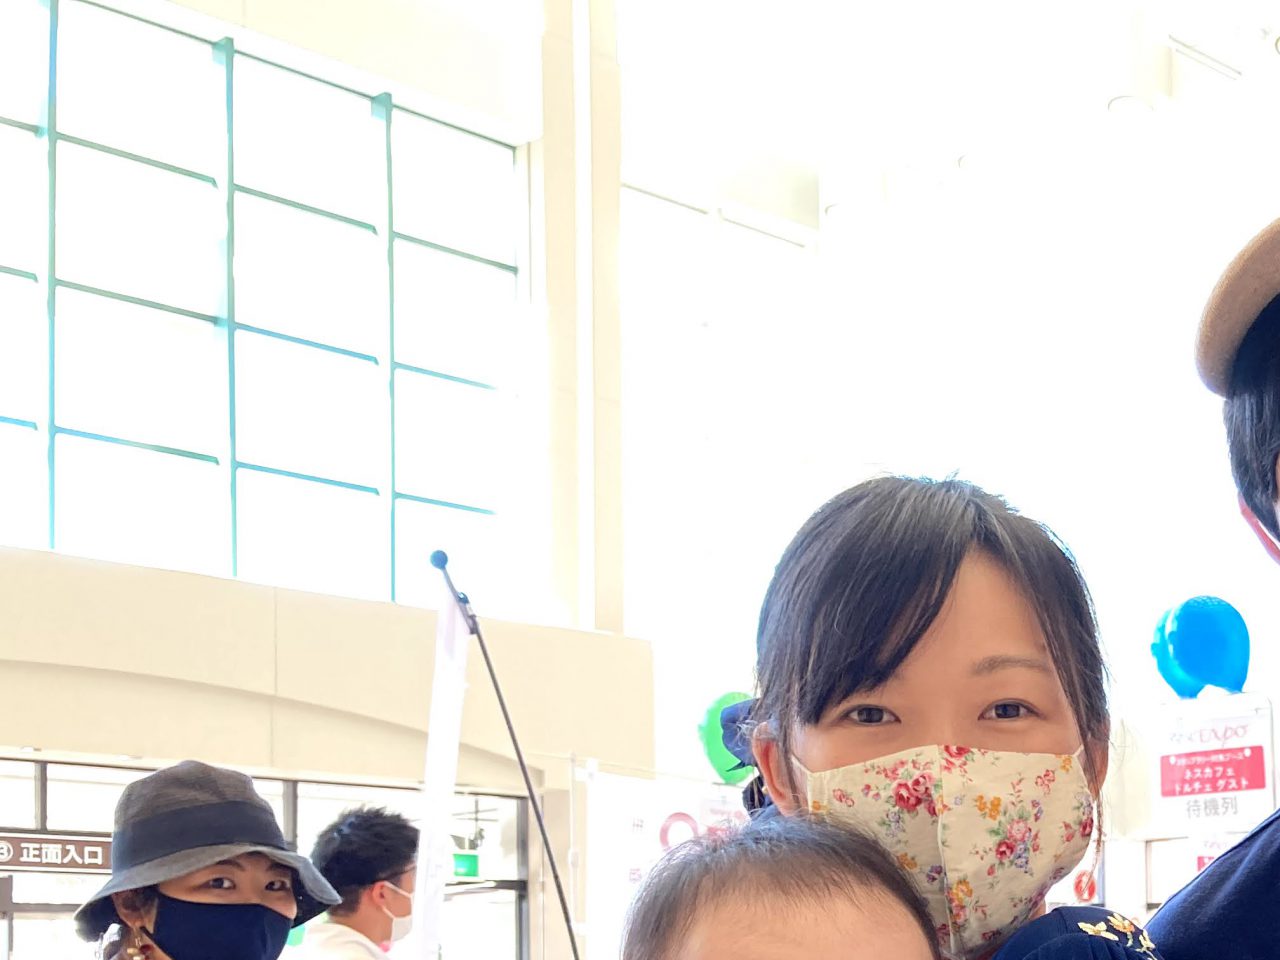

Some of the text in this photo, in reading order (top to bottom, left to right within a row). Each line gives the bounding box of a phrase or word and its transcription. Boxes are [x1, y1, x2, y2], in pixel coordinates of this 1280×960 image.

[1186, 796, 1238, 819] 待機列
[20, 843, 103, 865] 正面入口
